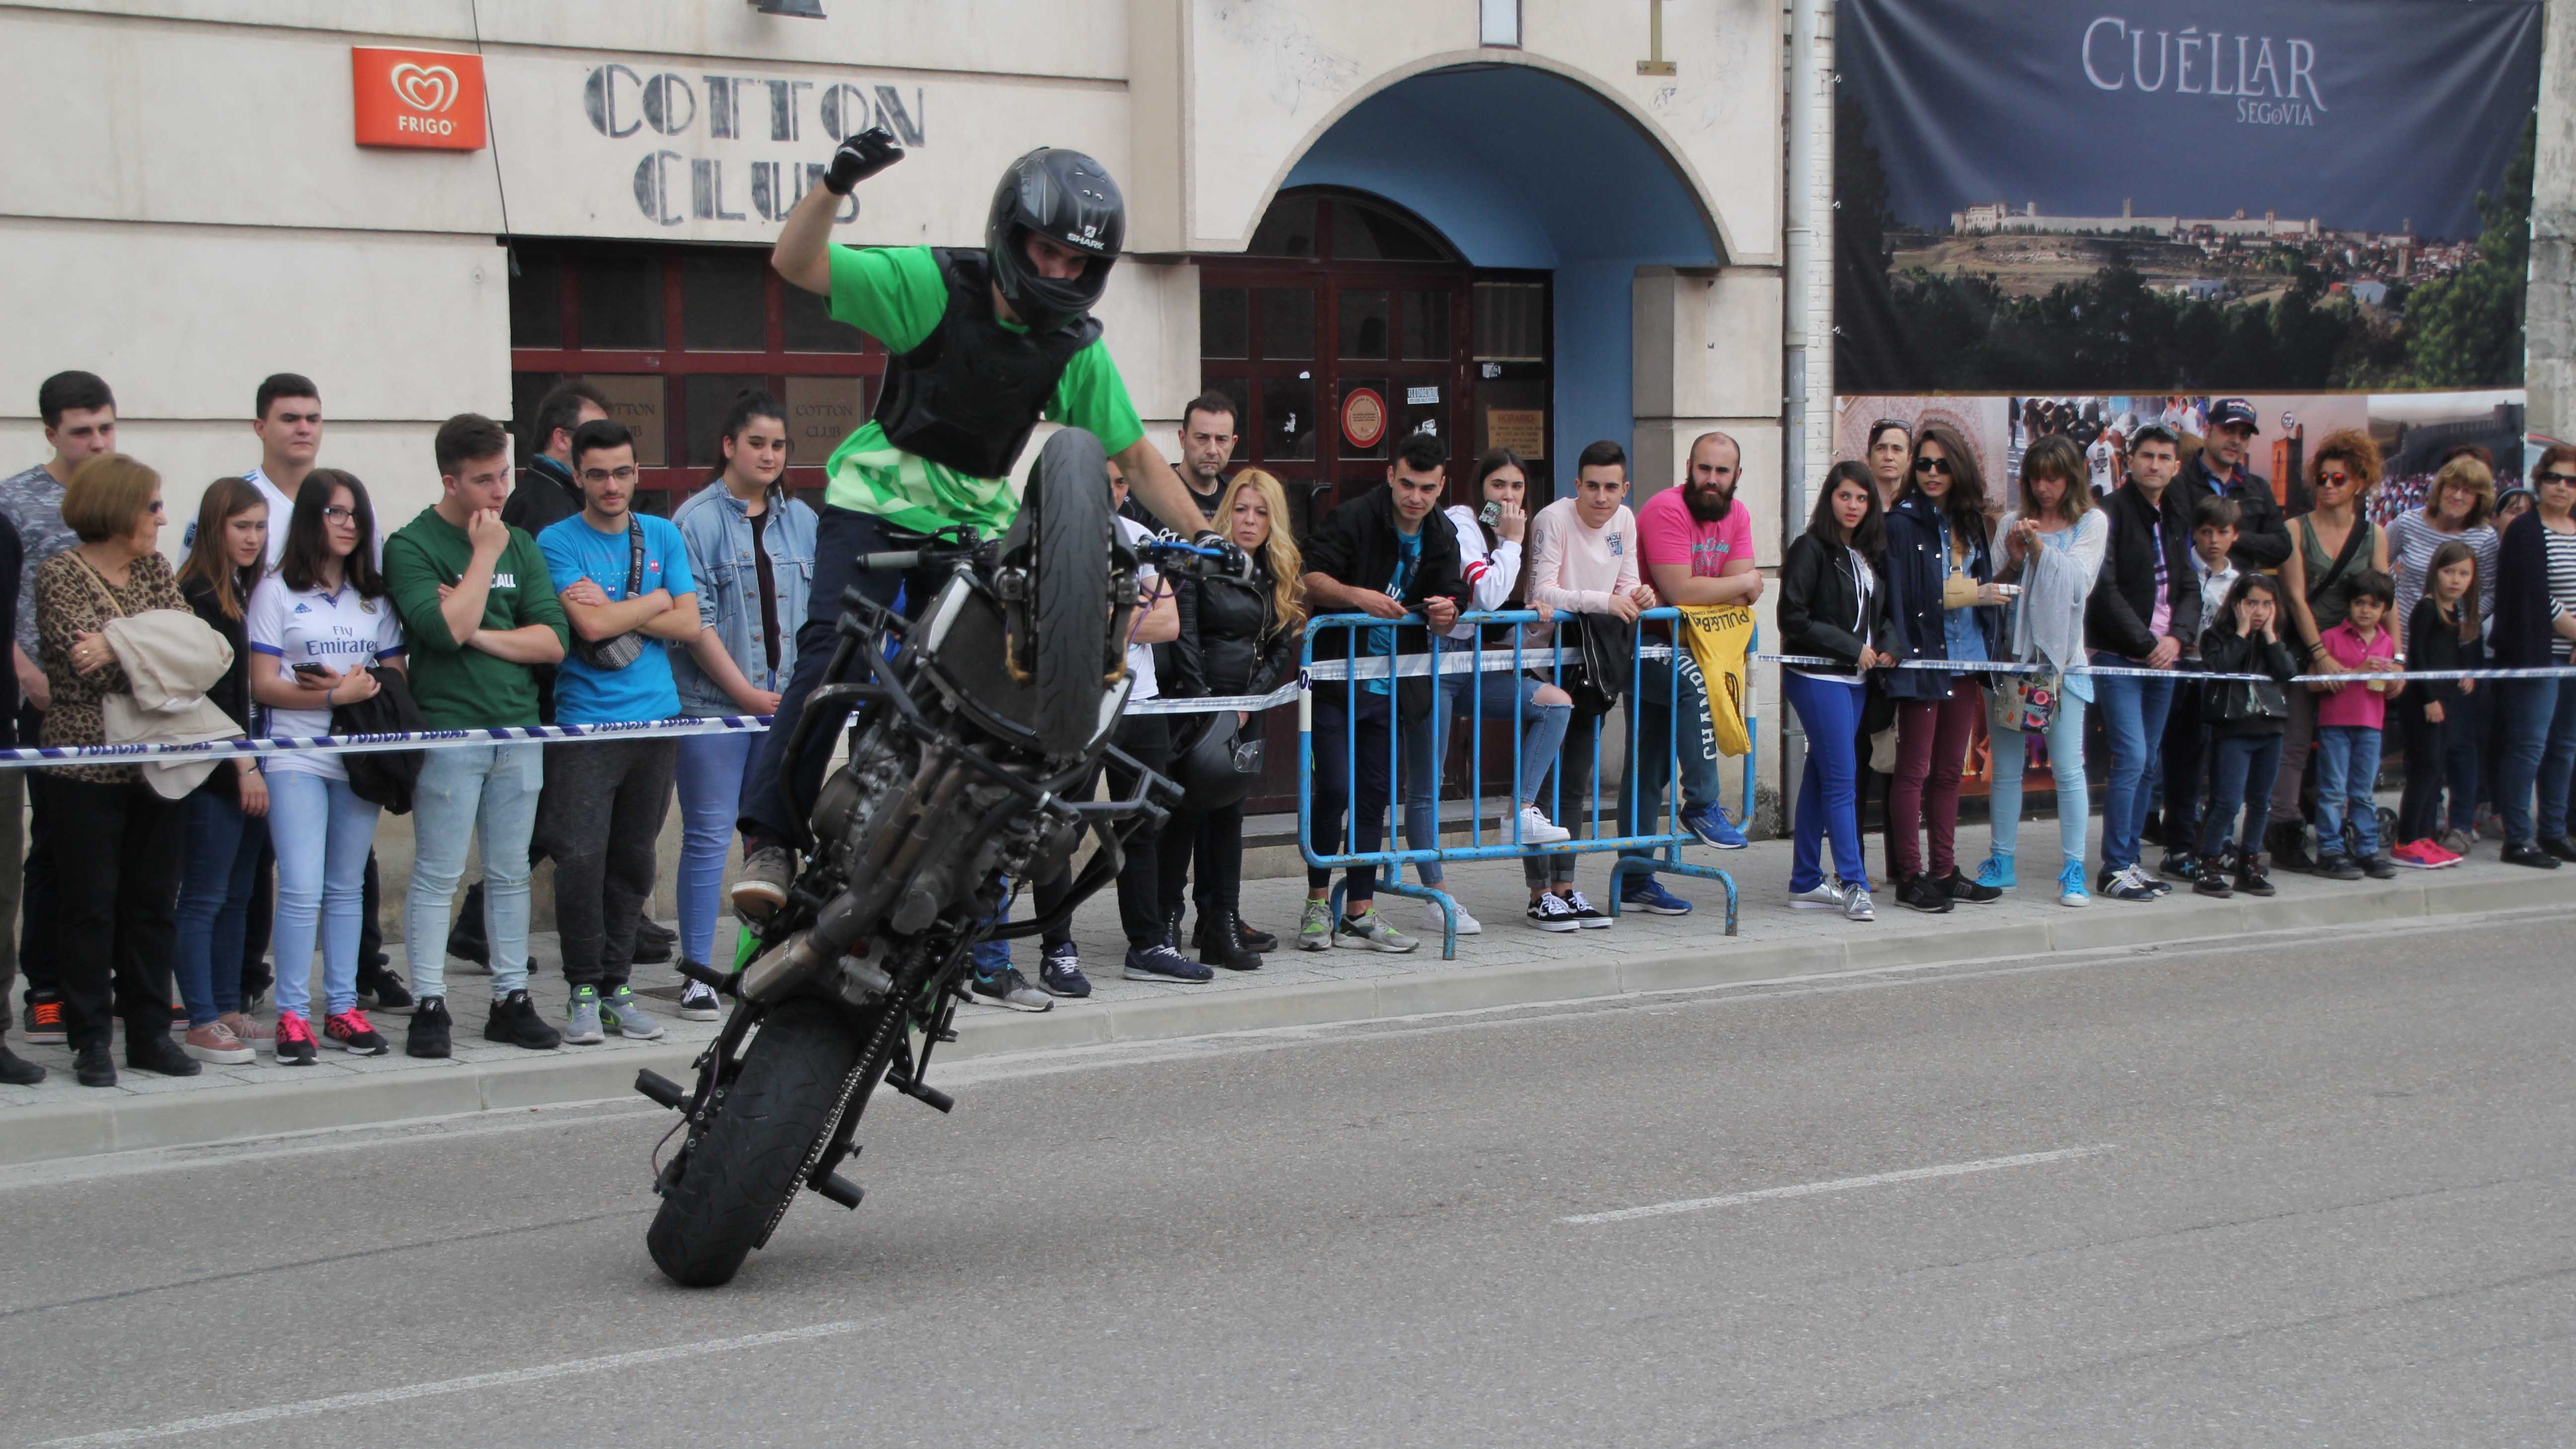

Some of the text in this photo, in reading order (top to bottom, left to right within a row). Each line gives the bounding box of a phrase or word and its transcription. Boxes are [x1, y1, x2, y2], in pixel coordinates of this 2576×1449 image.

[2082, 16, 2328, 112] CUÉLLAR
[583, 64, 925, 148] COTTON
[399, 115, 453, 136] FRIGO
[1067, 233, 1105, 250] SHARK
[796, 404, 852, 416] COTTON
[806, 425, 841, 438] CLUB
[333, 626, 353, 638] Fly
[306, 638, 378, 656] Emirates
